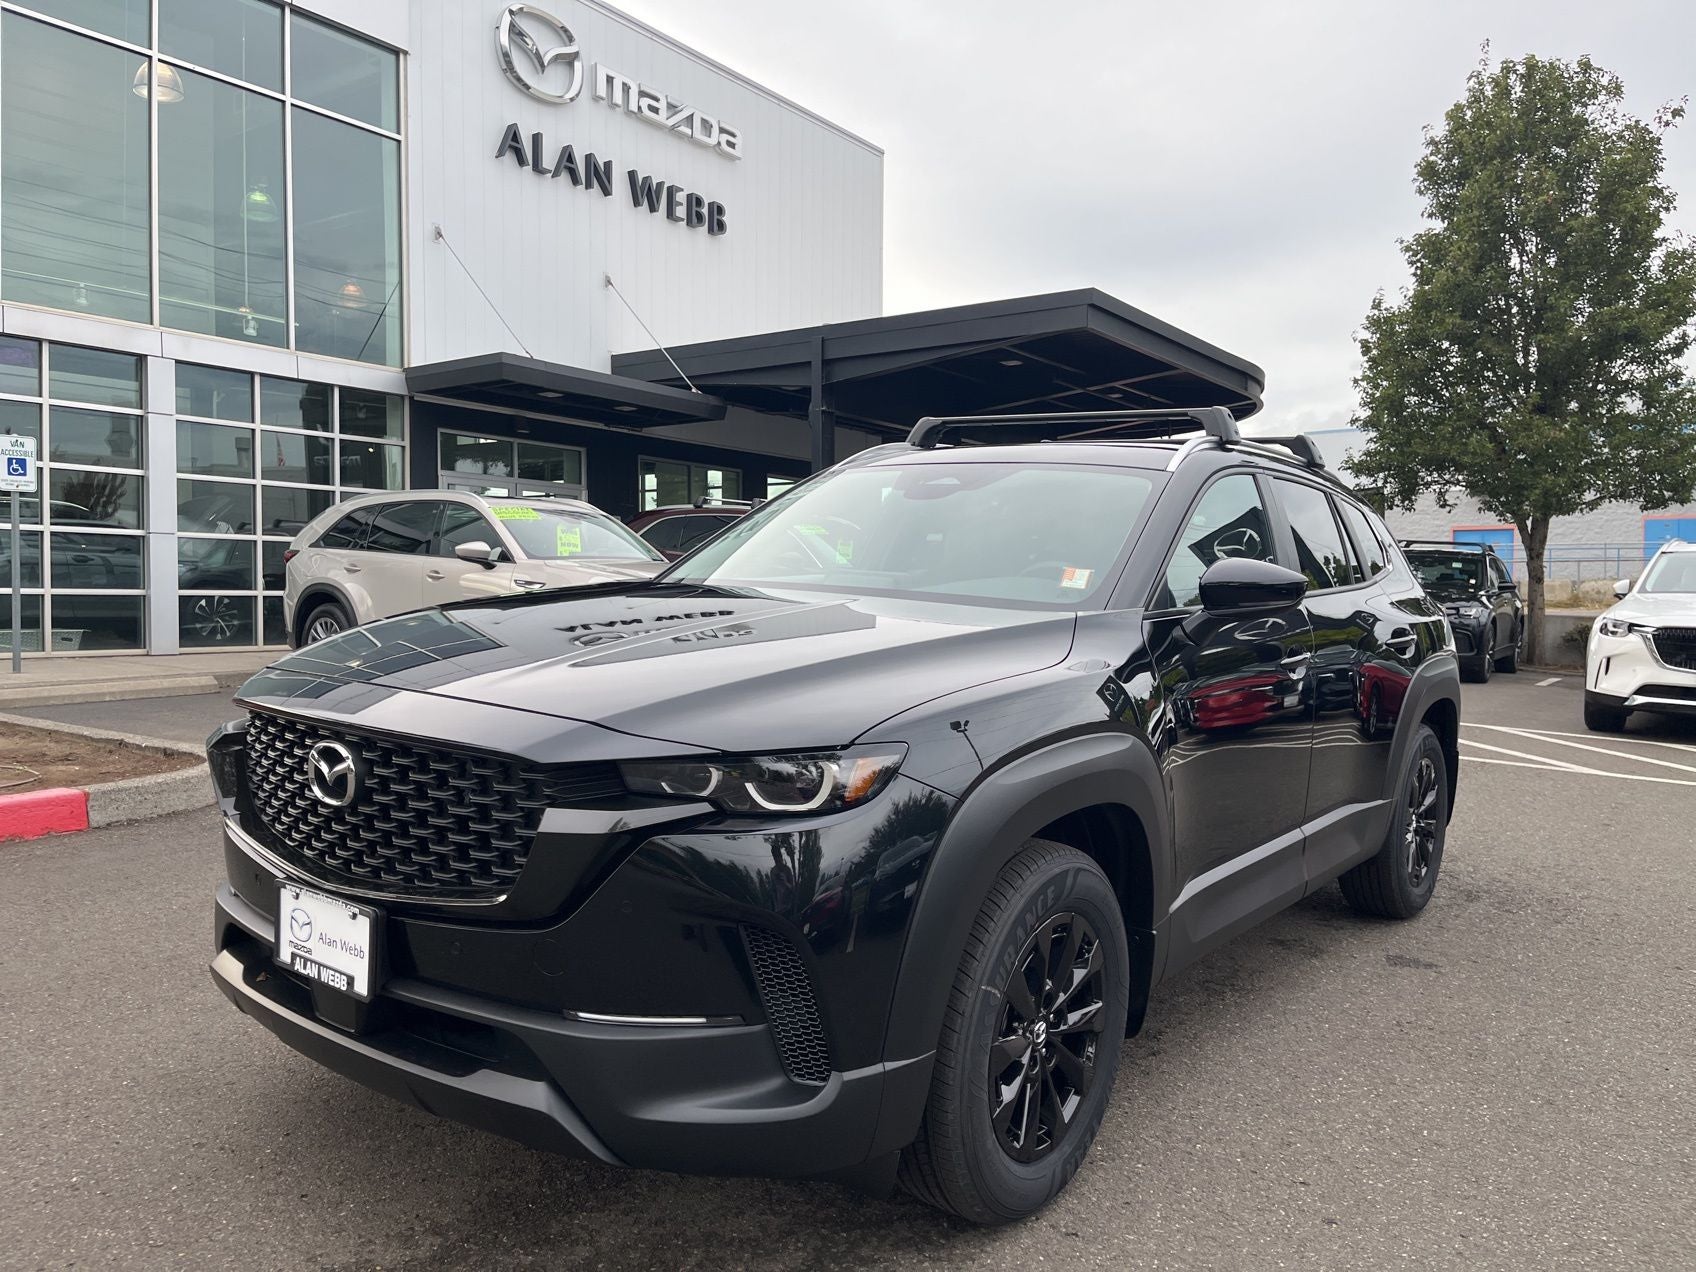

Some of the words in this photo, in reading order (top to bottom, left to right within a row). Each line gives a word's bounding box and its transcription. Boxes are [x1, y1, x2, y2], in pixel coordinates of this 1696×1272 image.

[591, 62, 742, 160] mazda
[495, 122, 613, 197] ALAN
[627, 169, 727, 236] WEBB
[0, 449, 34, 457] ACCESSIBLE
[10, 439, 24, 448] VAN
[288, 940, 312, 956] mazda
[317, 932, 338, 950] Alan
[340, 939, 365, 959] Webb
[294, 957, 319, 979] ALAN
[320, 966, 348, 991] WEBB
